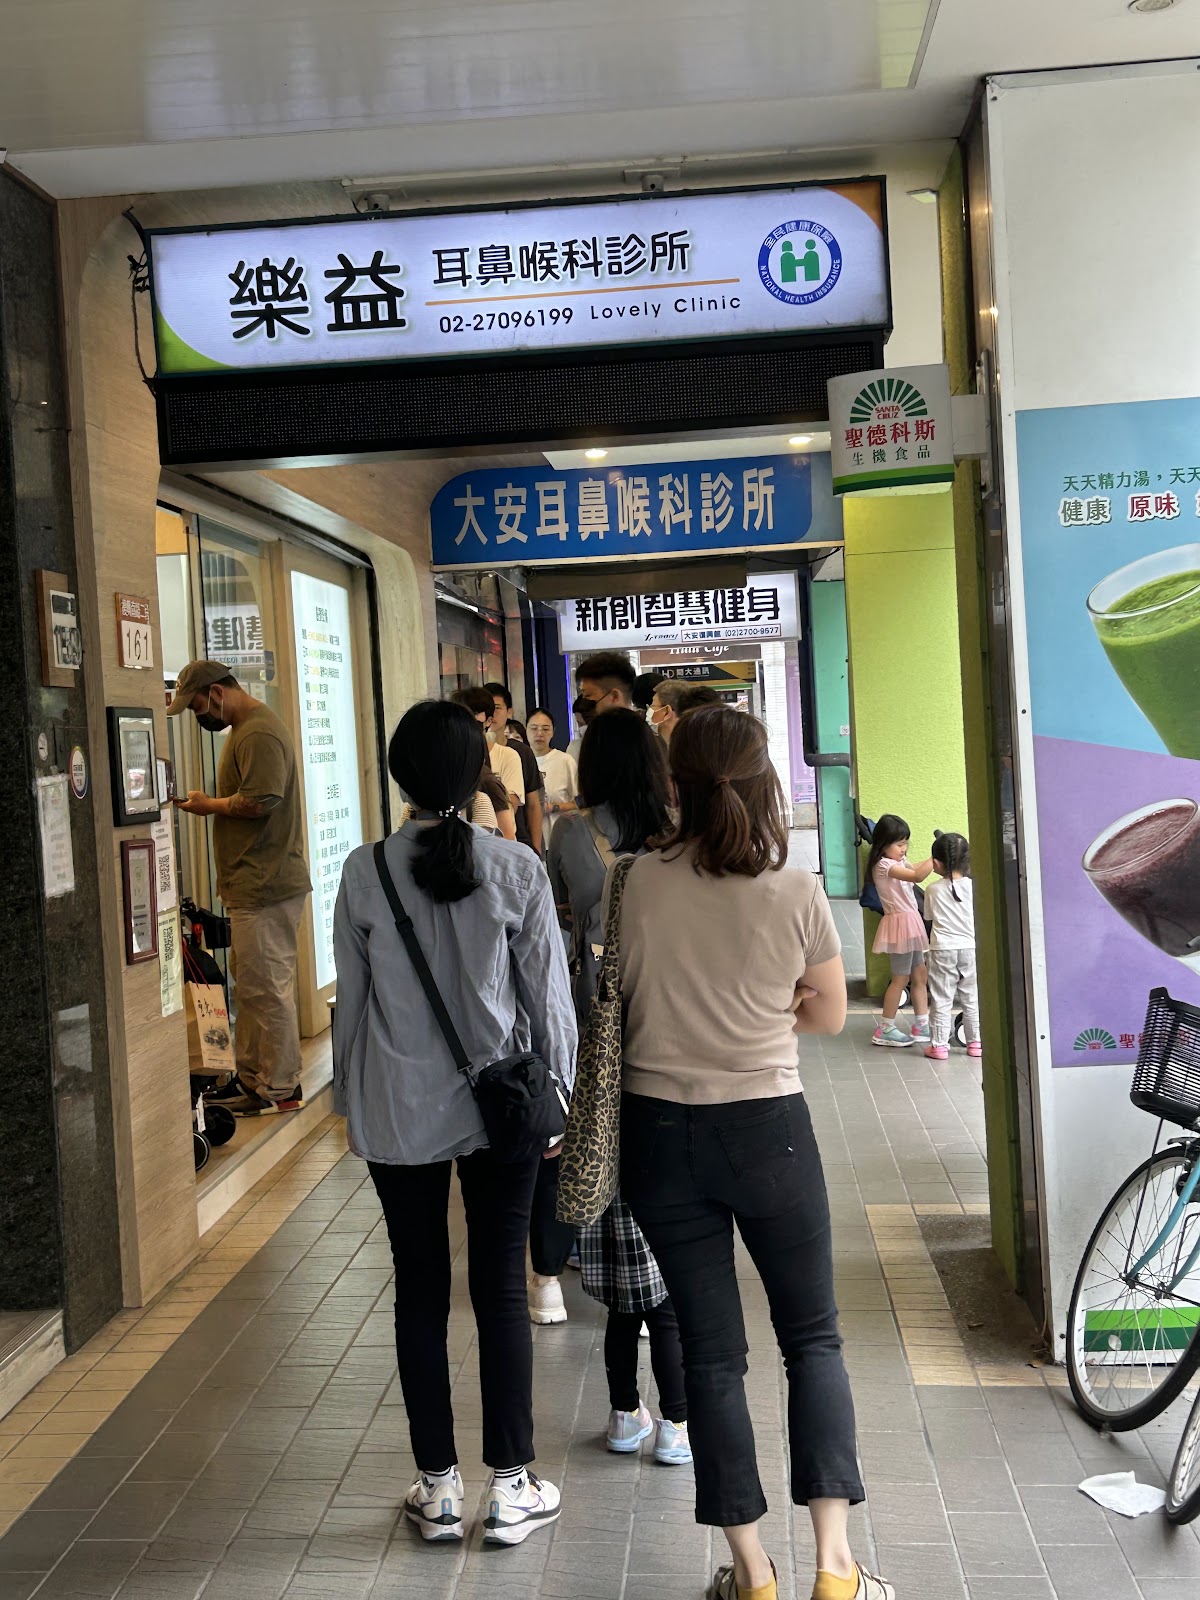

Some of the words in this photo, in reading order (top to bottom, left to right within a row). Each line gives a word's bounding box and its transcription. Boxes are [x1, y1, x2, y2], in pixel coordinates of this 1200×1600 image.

[432, 230, 690, 287] 耳鼻喉科診所
[228, 250, 406, 339] 樂益
[760, 265, 782, 298] NATIONAL
[784, 294, 814, 303] HEALTH
[815, 259, 840, 298] INSURANCE
[439, 307, 574, 334] 02-27096199
[590, 301, 662, 320] Lovely
[673, 295, 741, 314] Clinic
[874, 405, 901, 414] SANTA
[877, 412, 899, 420] CRUZ
[845, 419, 936, 449] 聖德科斯
[852, 444, 930, 466] 生機食品
[453, 467, 776, 546] 大安耳鼻喉科診所
[1060, 499, 1109, 524] 健康
[1129, 493, 1177, 518] 原味
[575, 587, 780, 632] 新創智慧健身
[126, 628, 149, 661] 161
